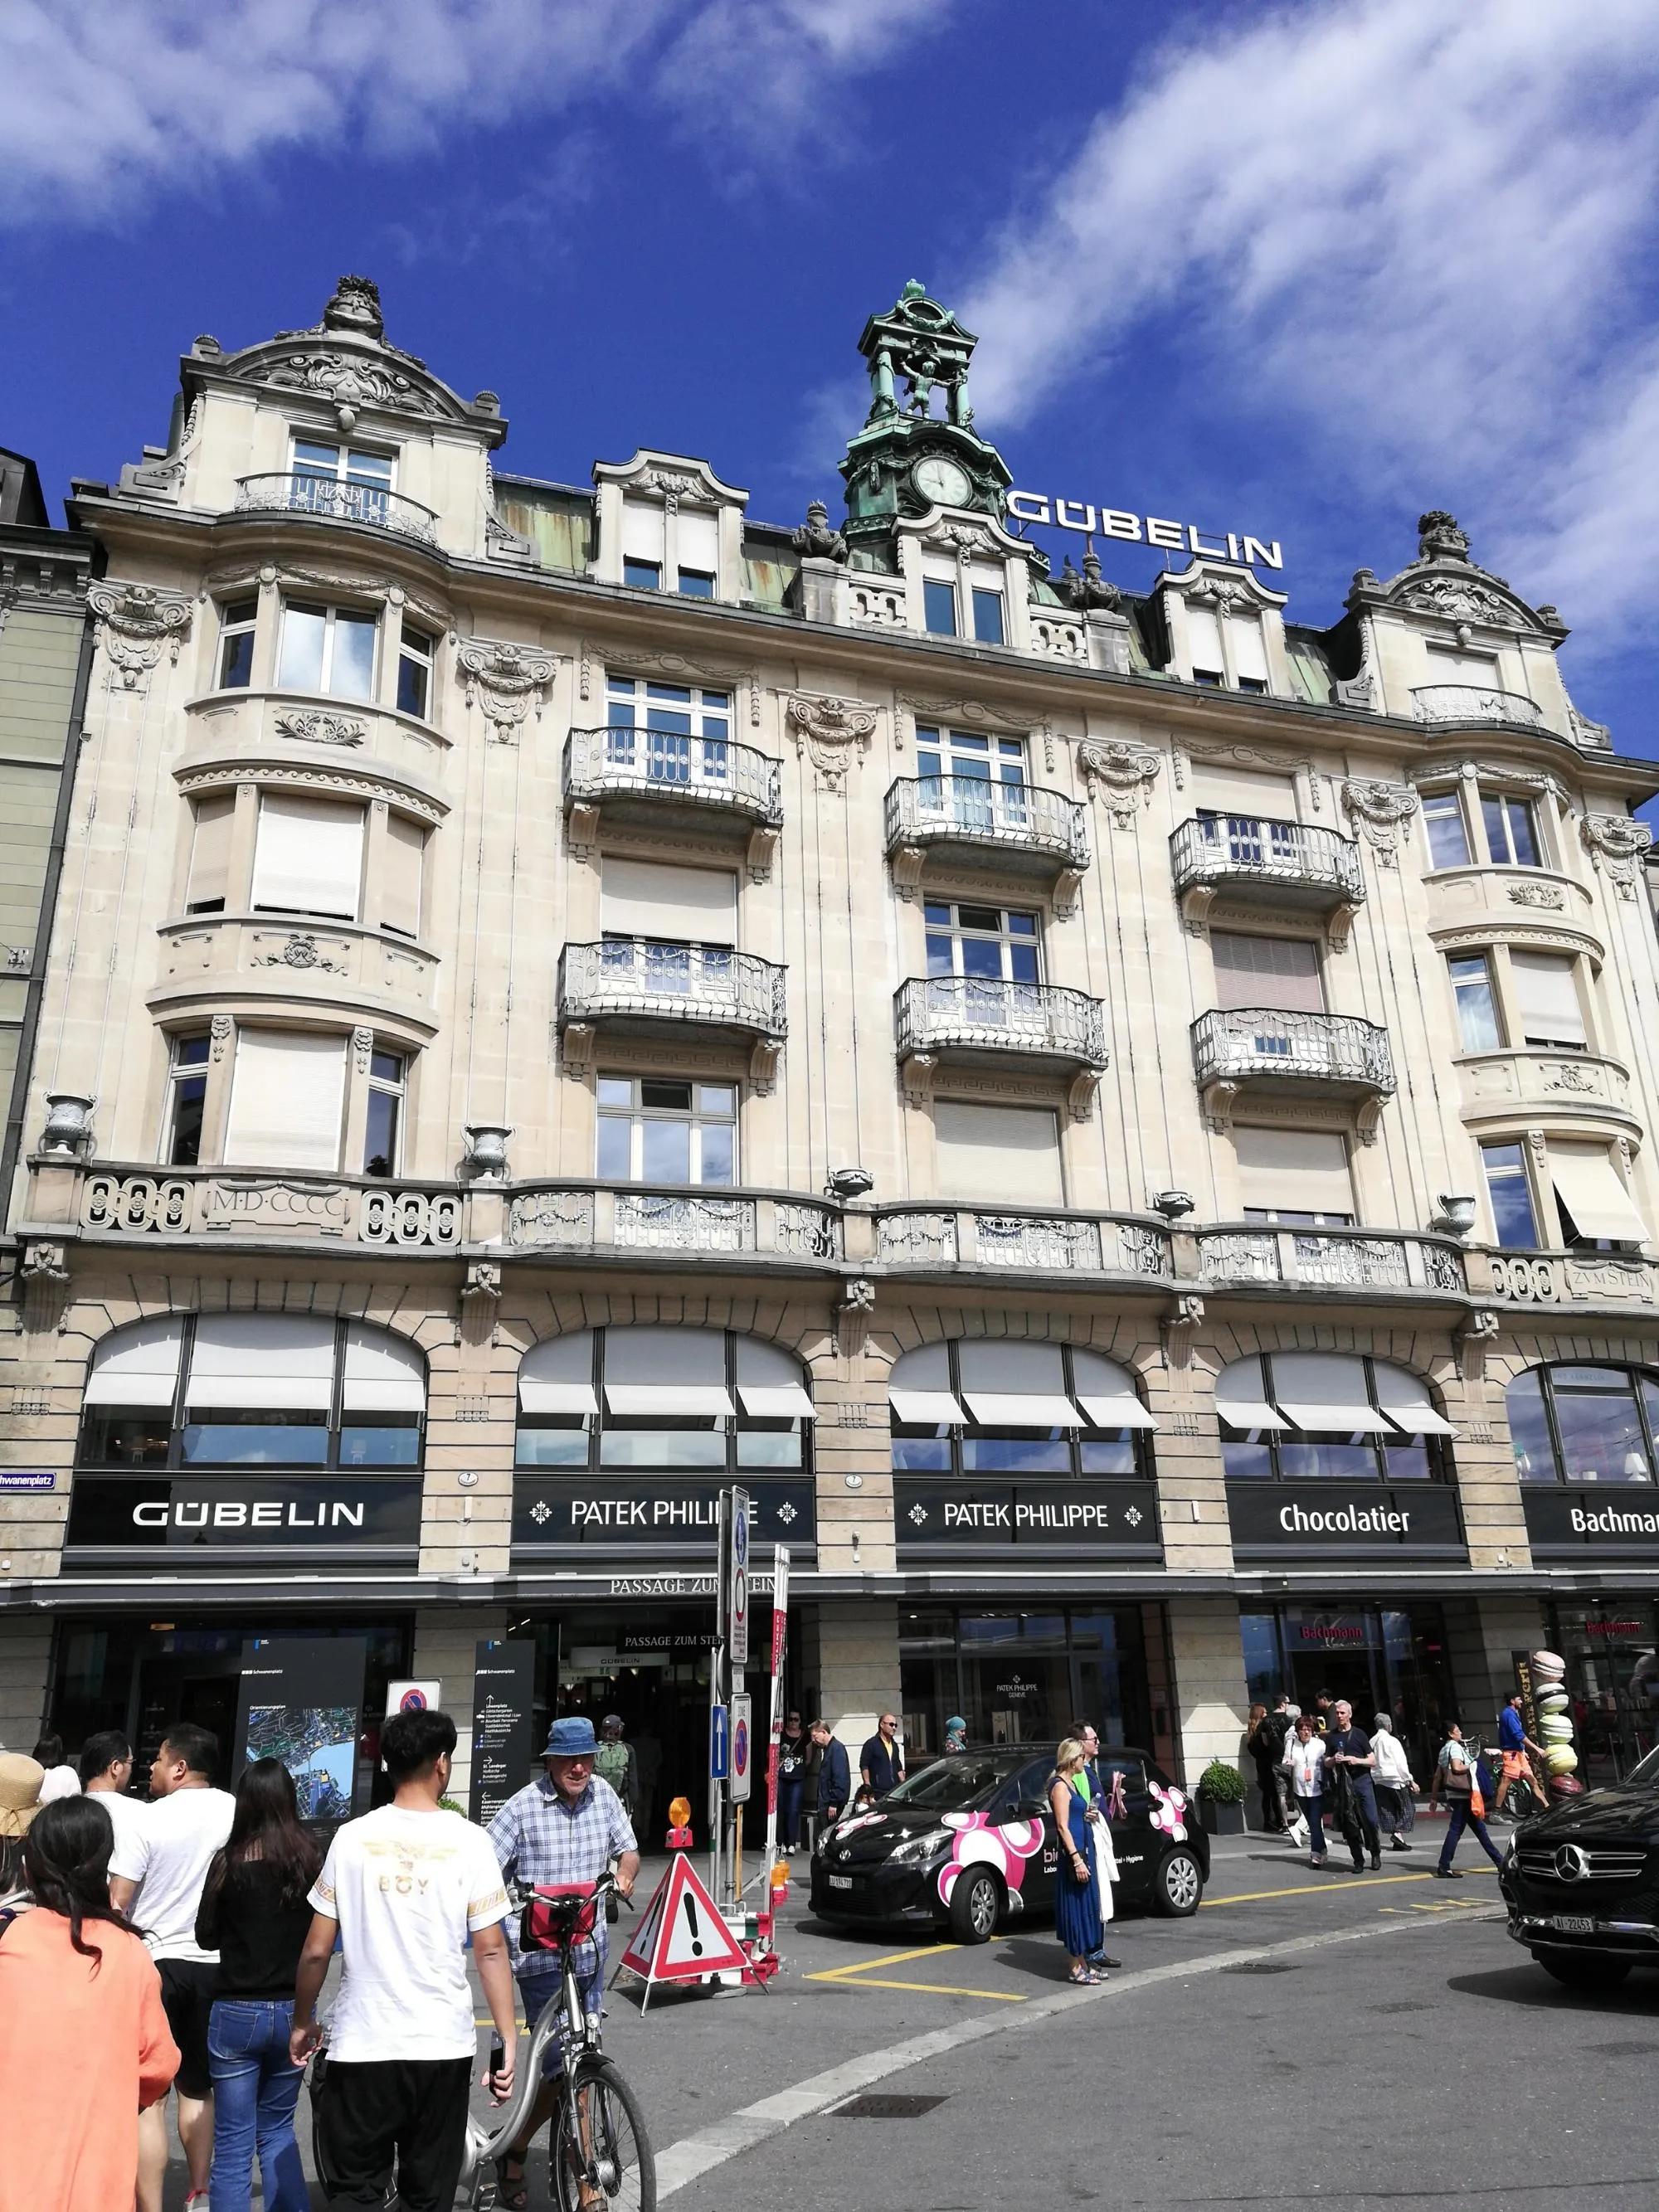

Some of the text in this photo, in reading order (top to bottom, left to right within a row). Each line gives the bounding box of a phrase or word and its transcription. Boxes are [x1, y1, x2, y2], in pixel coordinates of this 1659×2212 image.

[1006, 490, 1283, 570] GÜBELIN
[132, 1502, 364, 1527] GÜBELIN
[571, 1500, 759, 1524] PATEK PHILIE
[944, 1503, 1109, 1527] PATEK PHILIPPE
[1279, 1503, 1410, 1532] Chocolatier
[610, 1578, 686, 1594] PASSAGE
[625, 1636, 672, 1647] PASSAGE
[674, 1636, 698, 1646] ZUM
[1301, 1626, 1363, 1640] Bachmann
[1126, 1855, 1144, 1864] Hygiene
